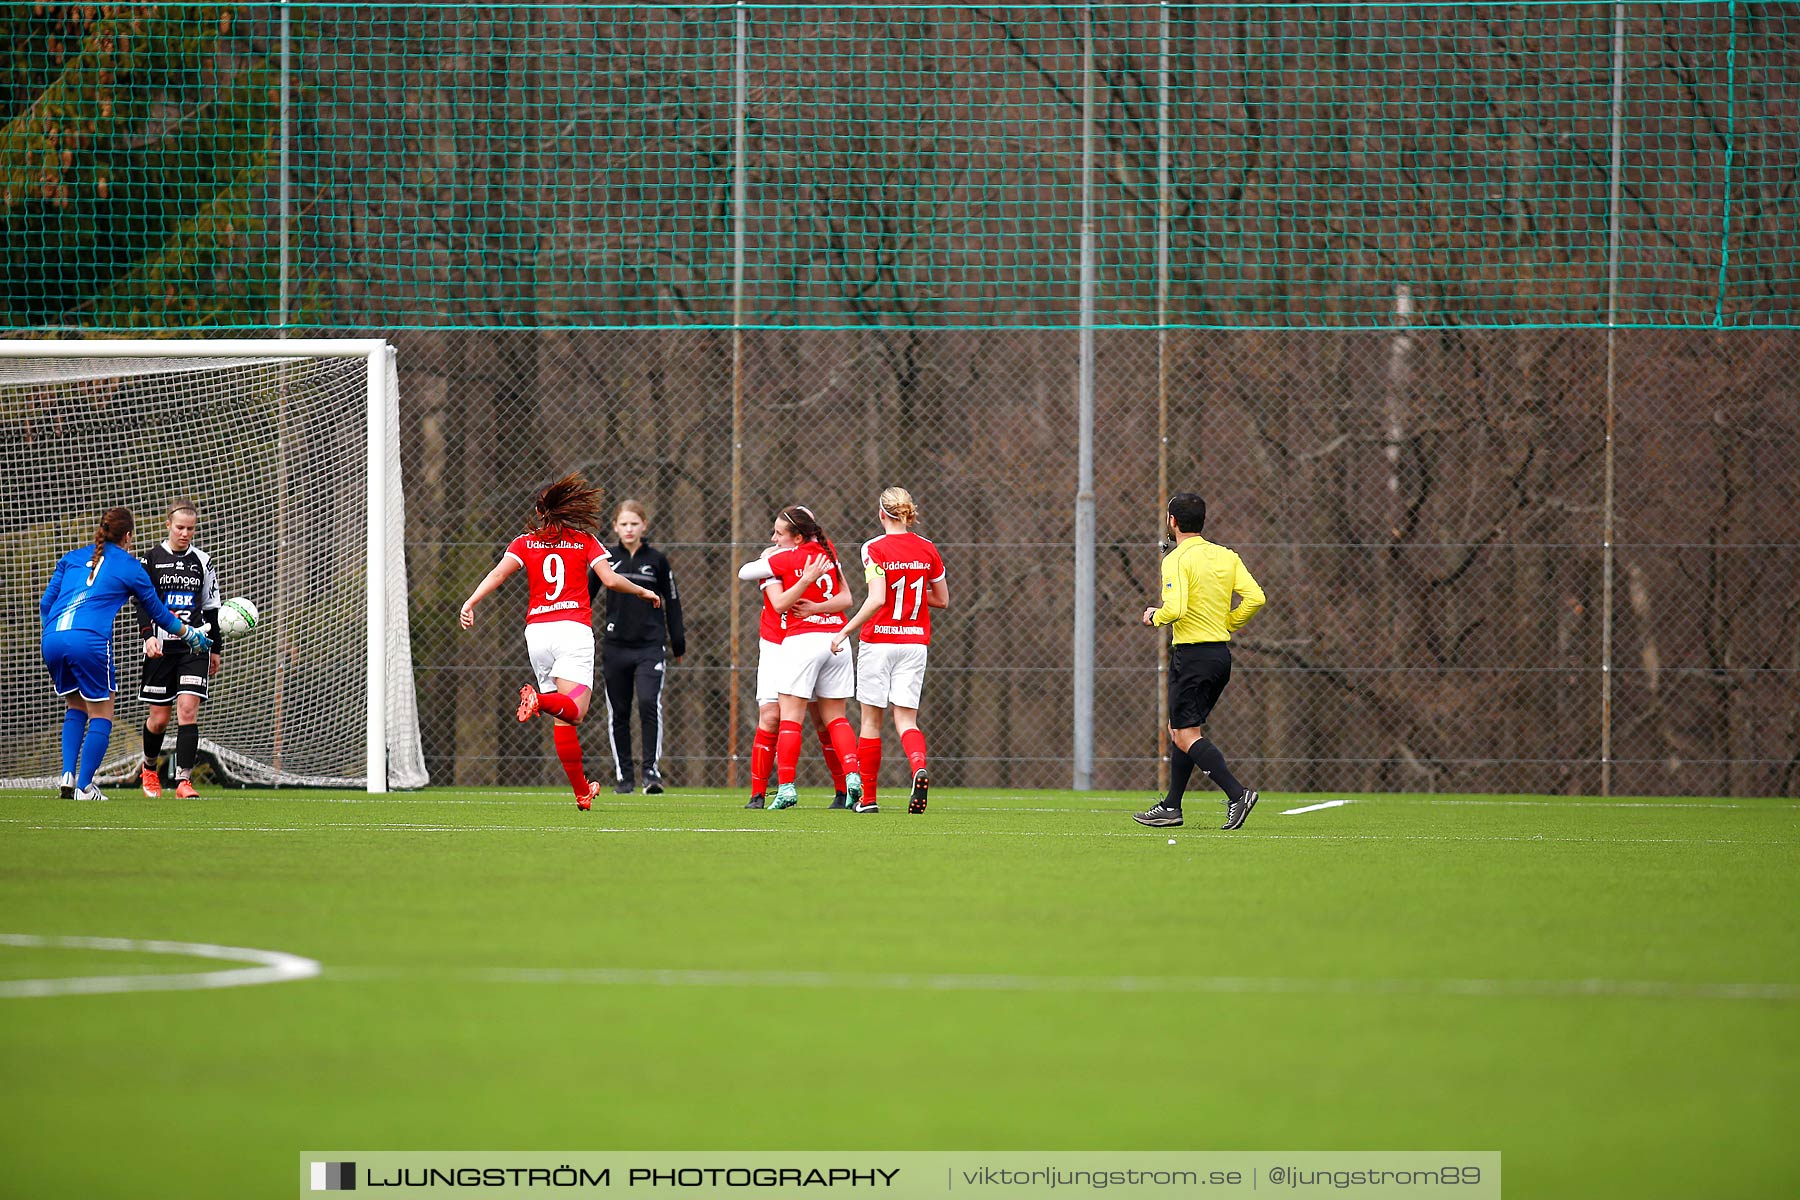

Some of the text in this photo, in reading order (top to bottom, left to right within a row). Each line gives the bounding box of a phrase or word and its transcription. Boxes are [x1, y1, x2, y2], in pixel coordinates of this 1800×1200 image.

[160, 573, 200, 588] ritningen
[542, 553, 565, 601] 9
[816, 573, 834, 600] 3
[167, 594, 193, 606] VBK
[891, 575, 924, 620] 11
